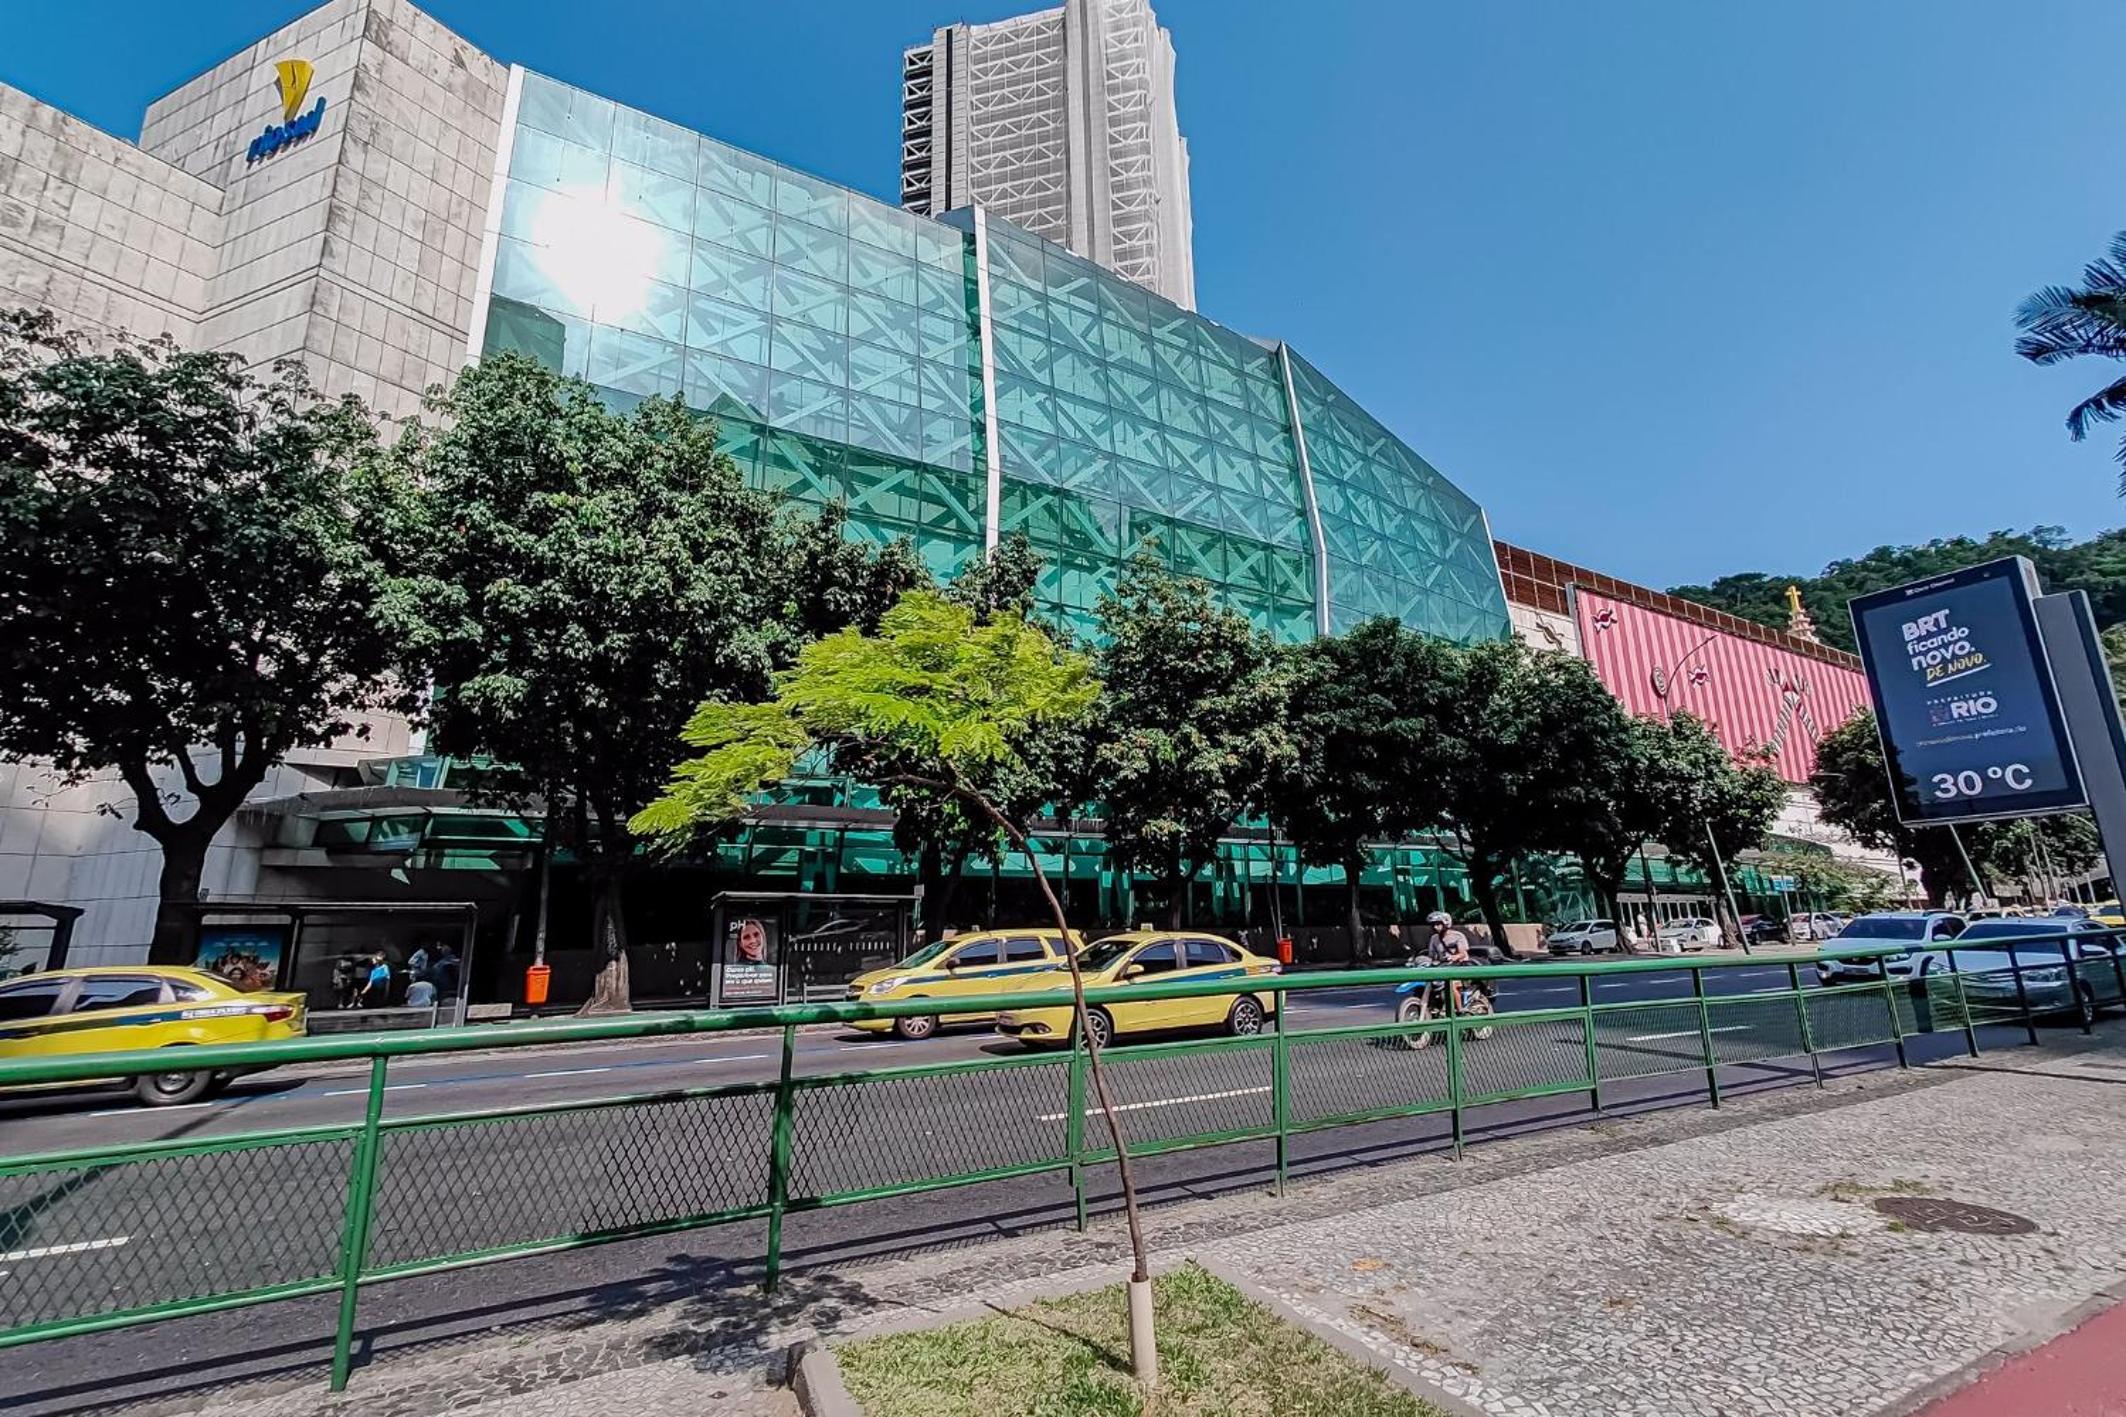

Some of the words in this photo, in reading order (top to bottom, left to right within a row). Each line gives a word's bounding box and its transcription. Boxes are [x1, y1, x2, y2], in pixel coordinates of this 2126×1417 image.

[1902, 609, 1950, 641] BRT
[1907, 627, 1969, 655] ficando
[1911, 641, 1976, 671] novo.
[1926, 664, 1945, 681] DE
[1950, 697, 1998, 719] RIO
[1931, 770, 1982, 799] 30
